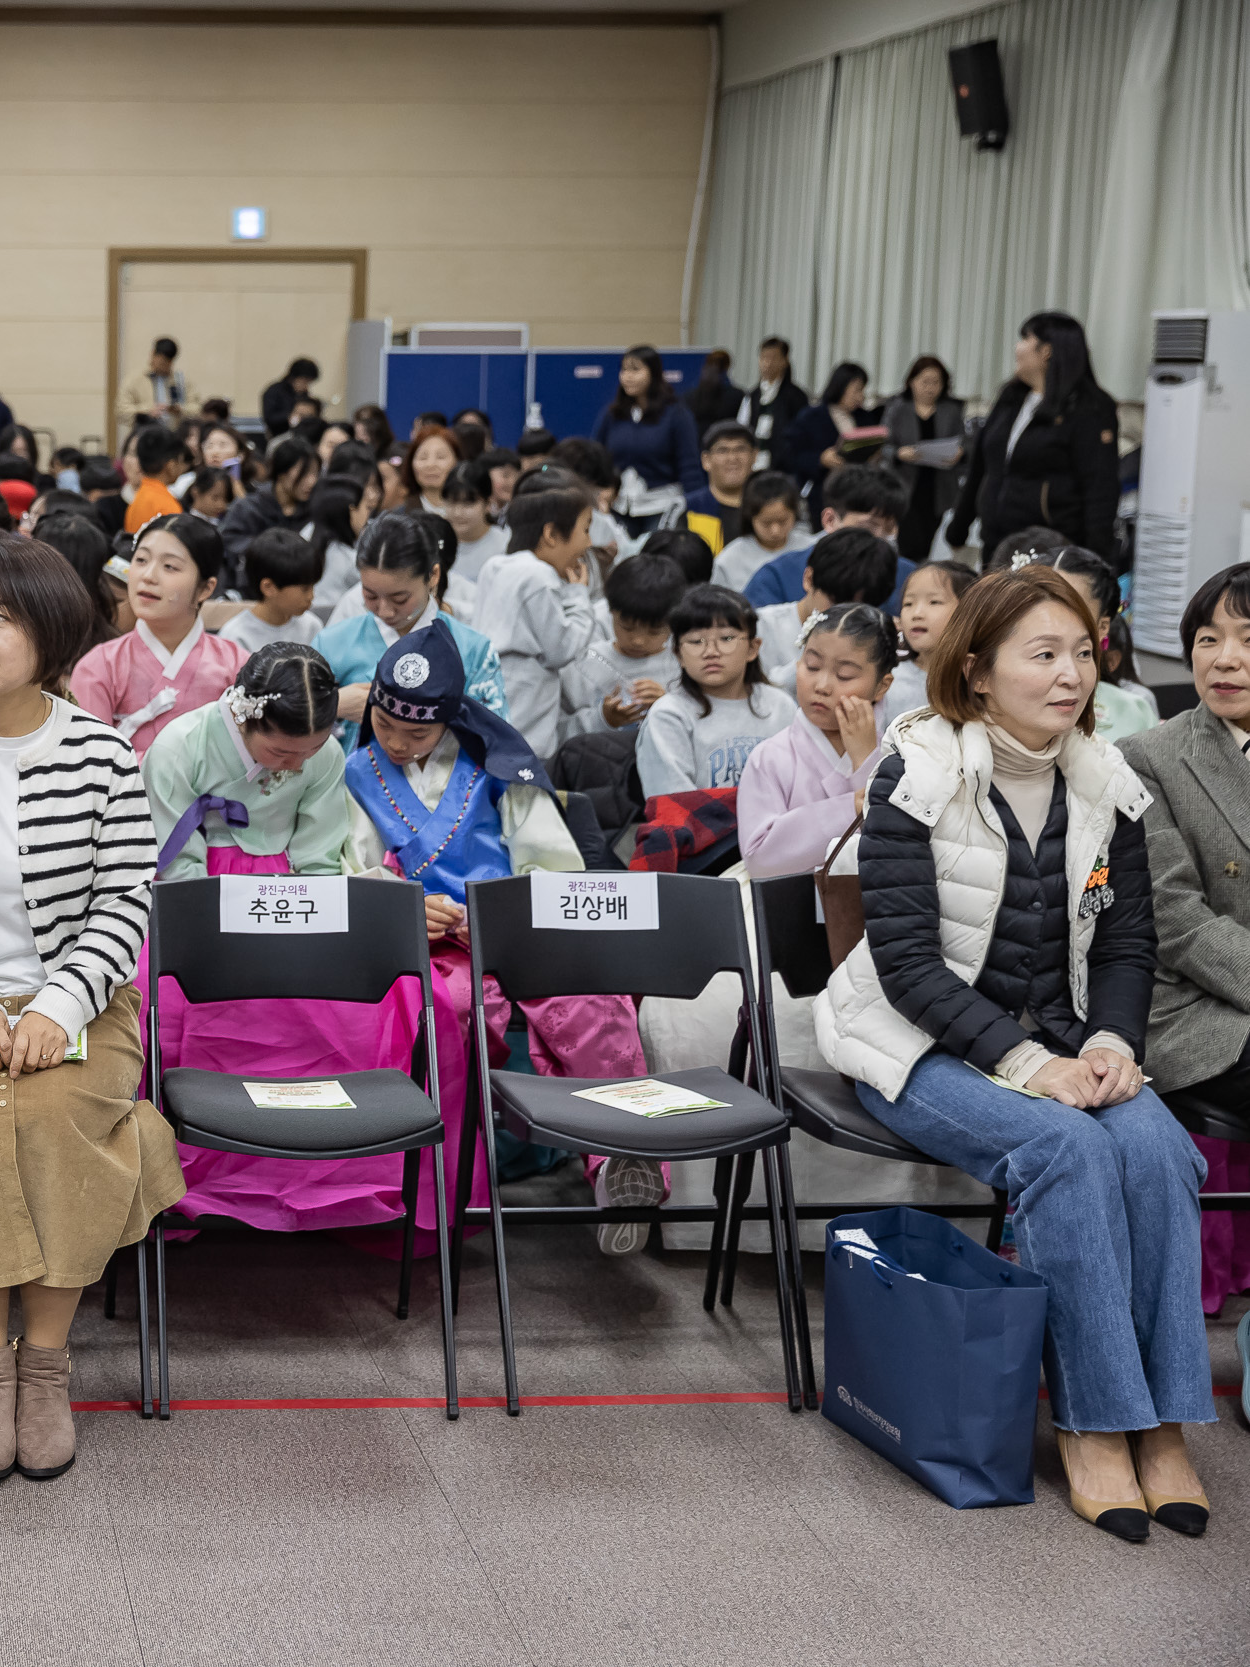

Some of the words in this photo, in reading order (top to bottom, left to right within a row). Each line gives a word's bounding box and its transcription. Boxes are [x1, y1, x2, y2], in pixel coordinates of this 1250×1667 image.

[257, 884, 308, 896] 광진구의원
[567, 880, 618, 893] 광진구의원
[247, 898, 319, 924] 추윤구
[558, 894, 629, 922] 김상배
